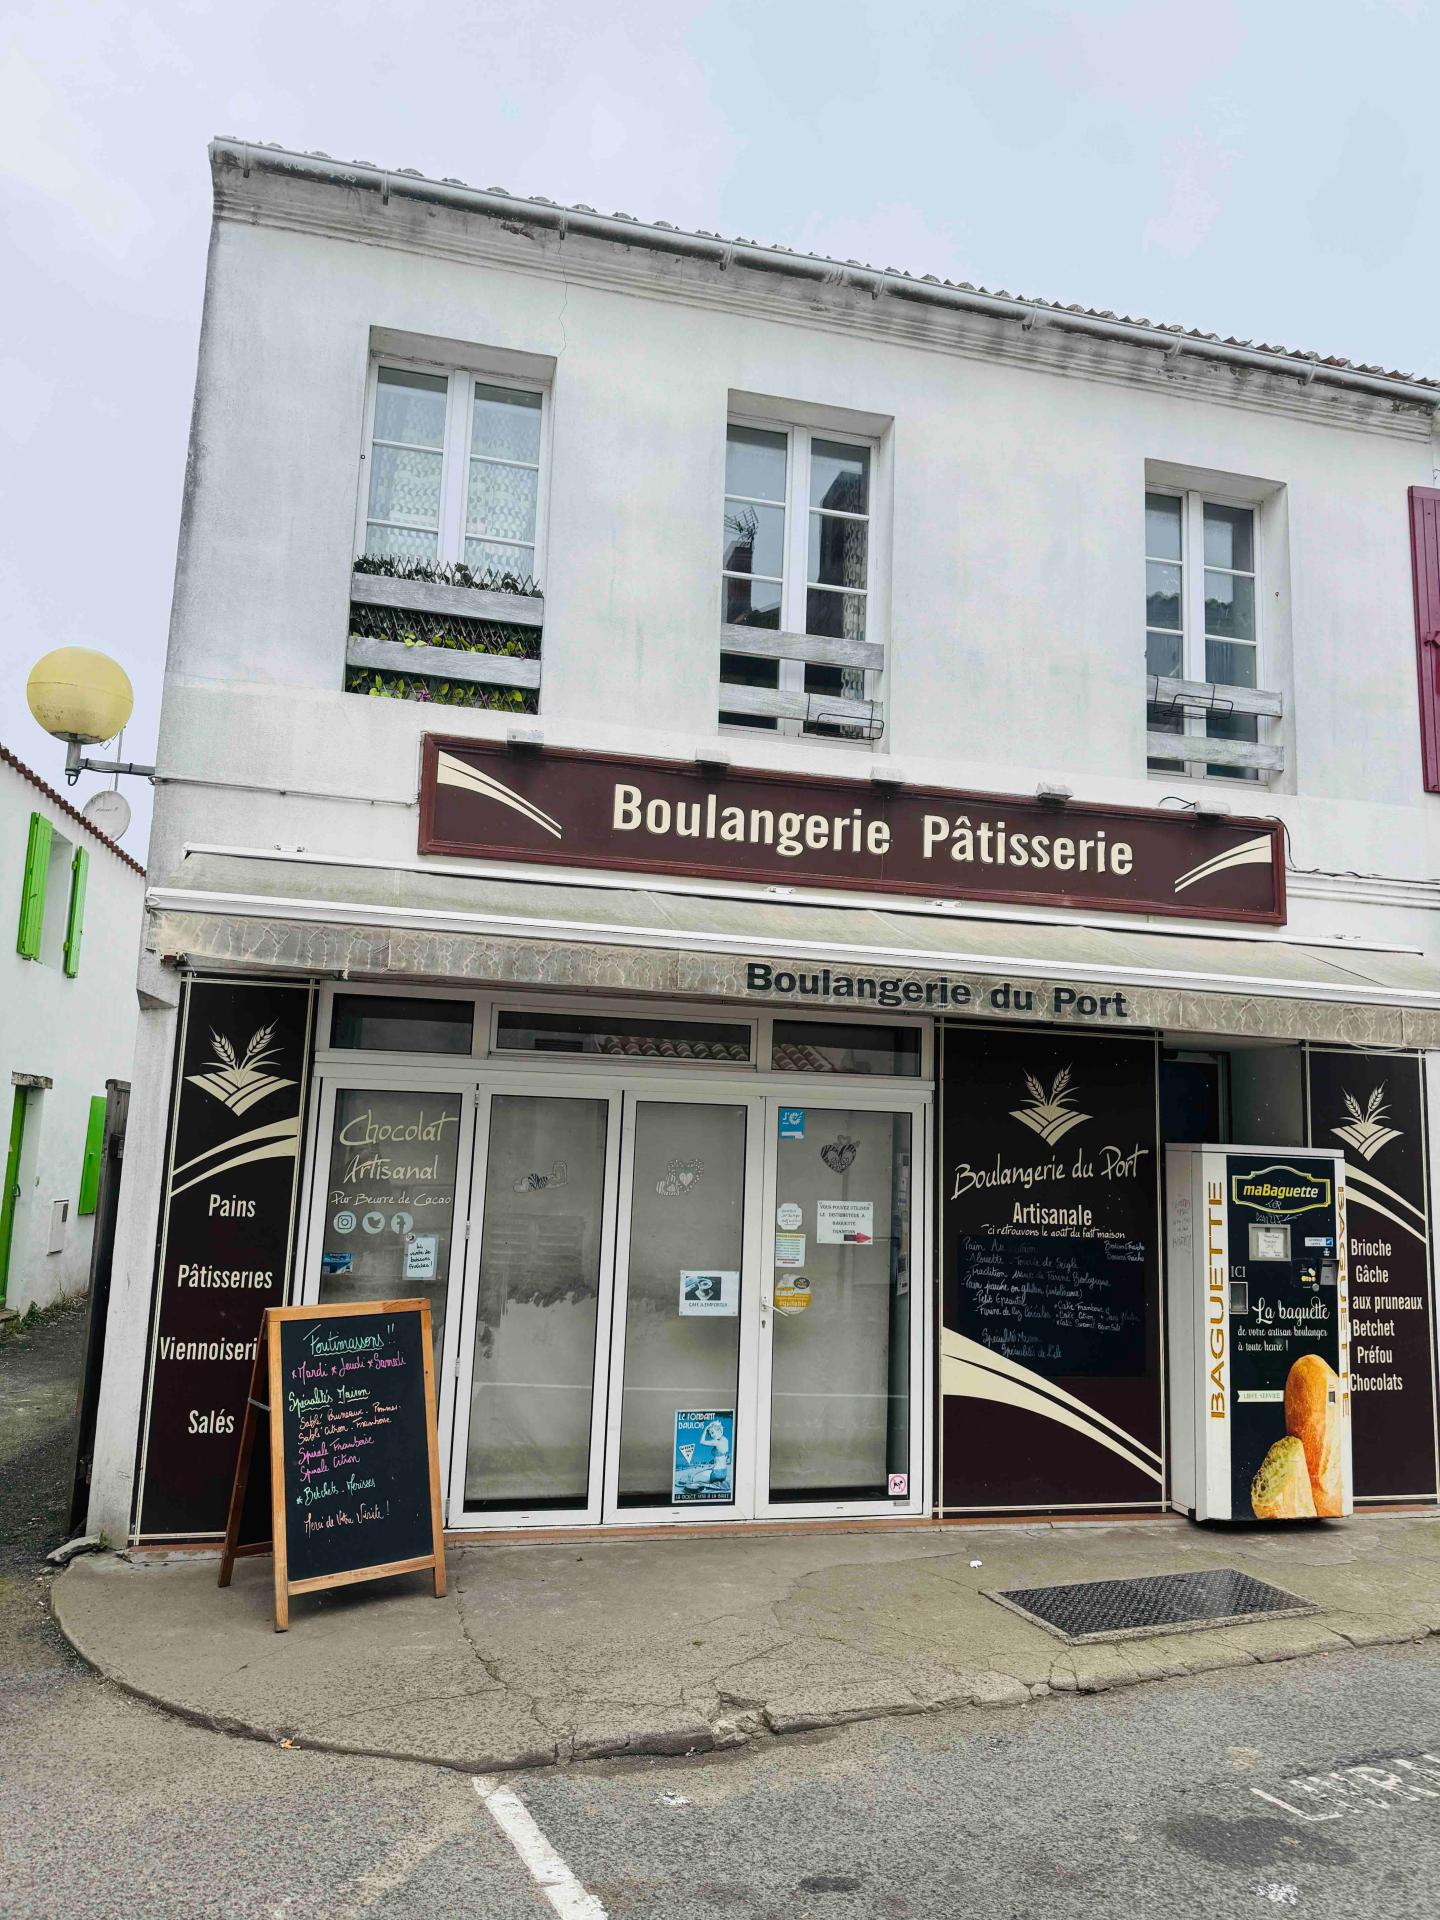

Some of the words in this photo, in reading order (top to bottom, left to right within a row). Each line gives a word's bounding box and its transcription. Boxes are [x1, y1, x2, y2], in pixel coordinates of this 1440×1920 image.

[612, 783, 891, 857] Boulangerie
[922, 814, 1133, 876] Pâtisserie
[746, 963, 972, 1007] Boulangerie
[990, 983, 1033, 1011] du
[1053, 987, 1128, 1018] Port
[340, 1109, 459, 1146] Chocolat
[343, 1154, 438, 1184] Artisanal
[950, 1153, 1066, 1200] Boulangerie
[1071, 1147, 1094, 1178] du
[1099, 1143, 1149, 1180] Port
[331, 1190, 352, 1205] Pur
[353, 1193, 394, 1206] Beurre
[398, 1191, 411, 1205] de
[413, 1193, 452, 1207] Cacao
[1243, 1183, 1319, 1199] maBaguette
[208, 1193, 256, 1217] Pains
[1012, 1202, 1092, 1226] Artisanale
[1041, 1225, 1049, 1237] le
[1070, 1226, 1081, 1238] du
[1097, 1228, 1126, 1240] maison
[1351, 1238, 1392, 1256] Brioche
[177, 1263, 273, 1289] Pâtisseries
[1231, 1265, 1246, 1278] ICI
[1355, 1264, 1389, 1283] Gâche
[1208, 1181, 1226, 1419] BAGUETTE
[1352, 1296, 1371, 1310] aux
[1374, 1296, 1423, 1313] pruneaux
[1251, 1297, 1276, 1324] La
[1277, 1296, 1330, 1327] baguette
[1237, 1325, 1247, 1336] de
[1248, 1328, 1266, 1337] votre
[1267, 1328, 1292, 1337] artisan
[1293, 1325, 1328, 1341] boulanger
[1353, 1318, 1395, 1337] Betchet
[1237, 1341, 1244, 1351] à
[1245, 1343, 1263, 1351] toute
[1263, 1340, 1283, 1352] heure
[1357, 1344, 1393, 1364] Préfou
[298, 1361, 329, 1386] Mardi
[338, 1355, 366, 1377] Jeudi
[373, 1350, 407, 1370] Samedi
[1350, 1373, 1403, 1391] Chocolats
[337, 1384, 371, 1405] Maison
[187, 1408, 235, 1434] Salés
[333, 1454, 361, 1469] Citron
[325, 1515, 335, 1529] de
